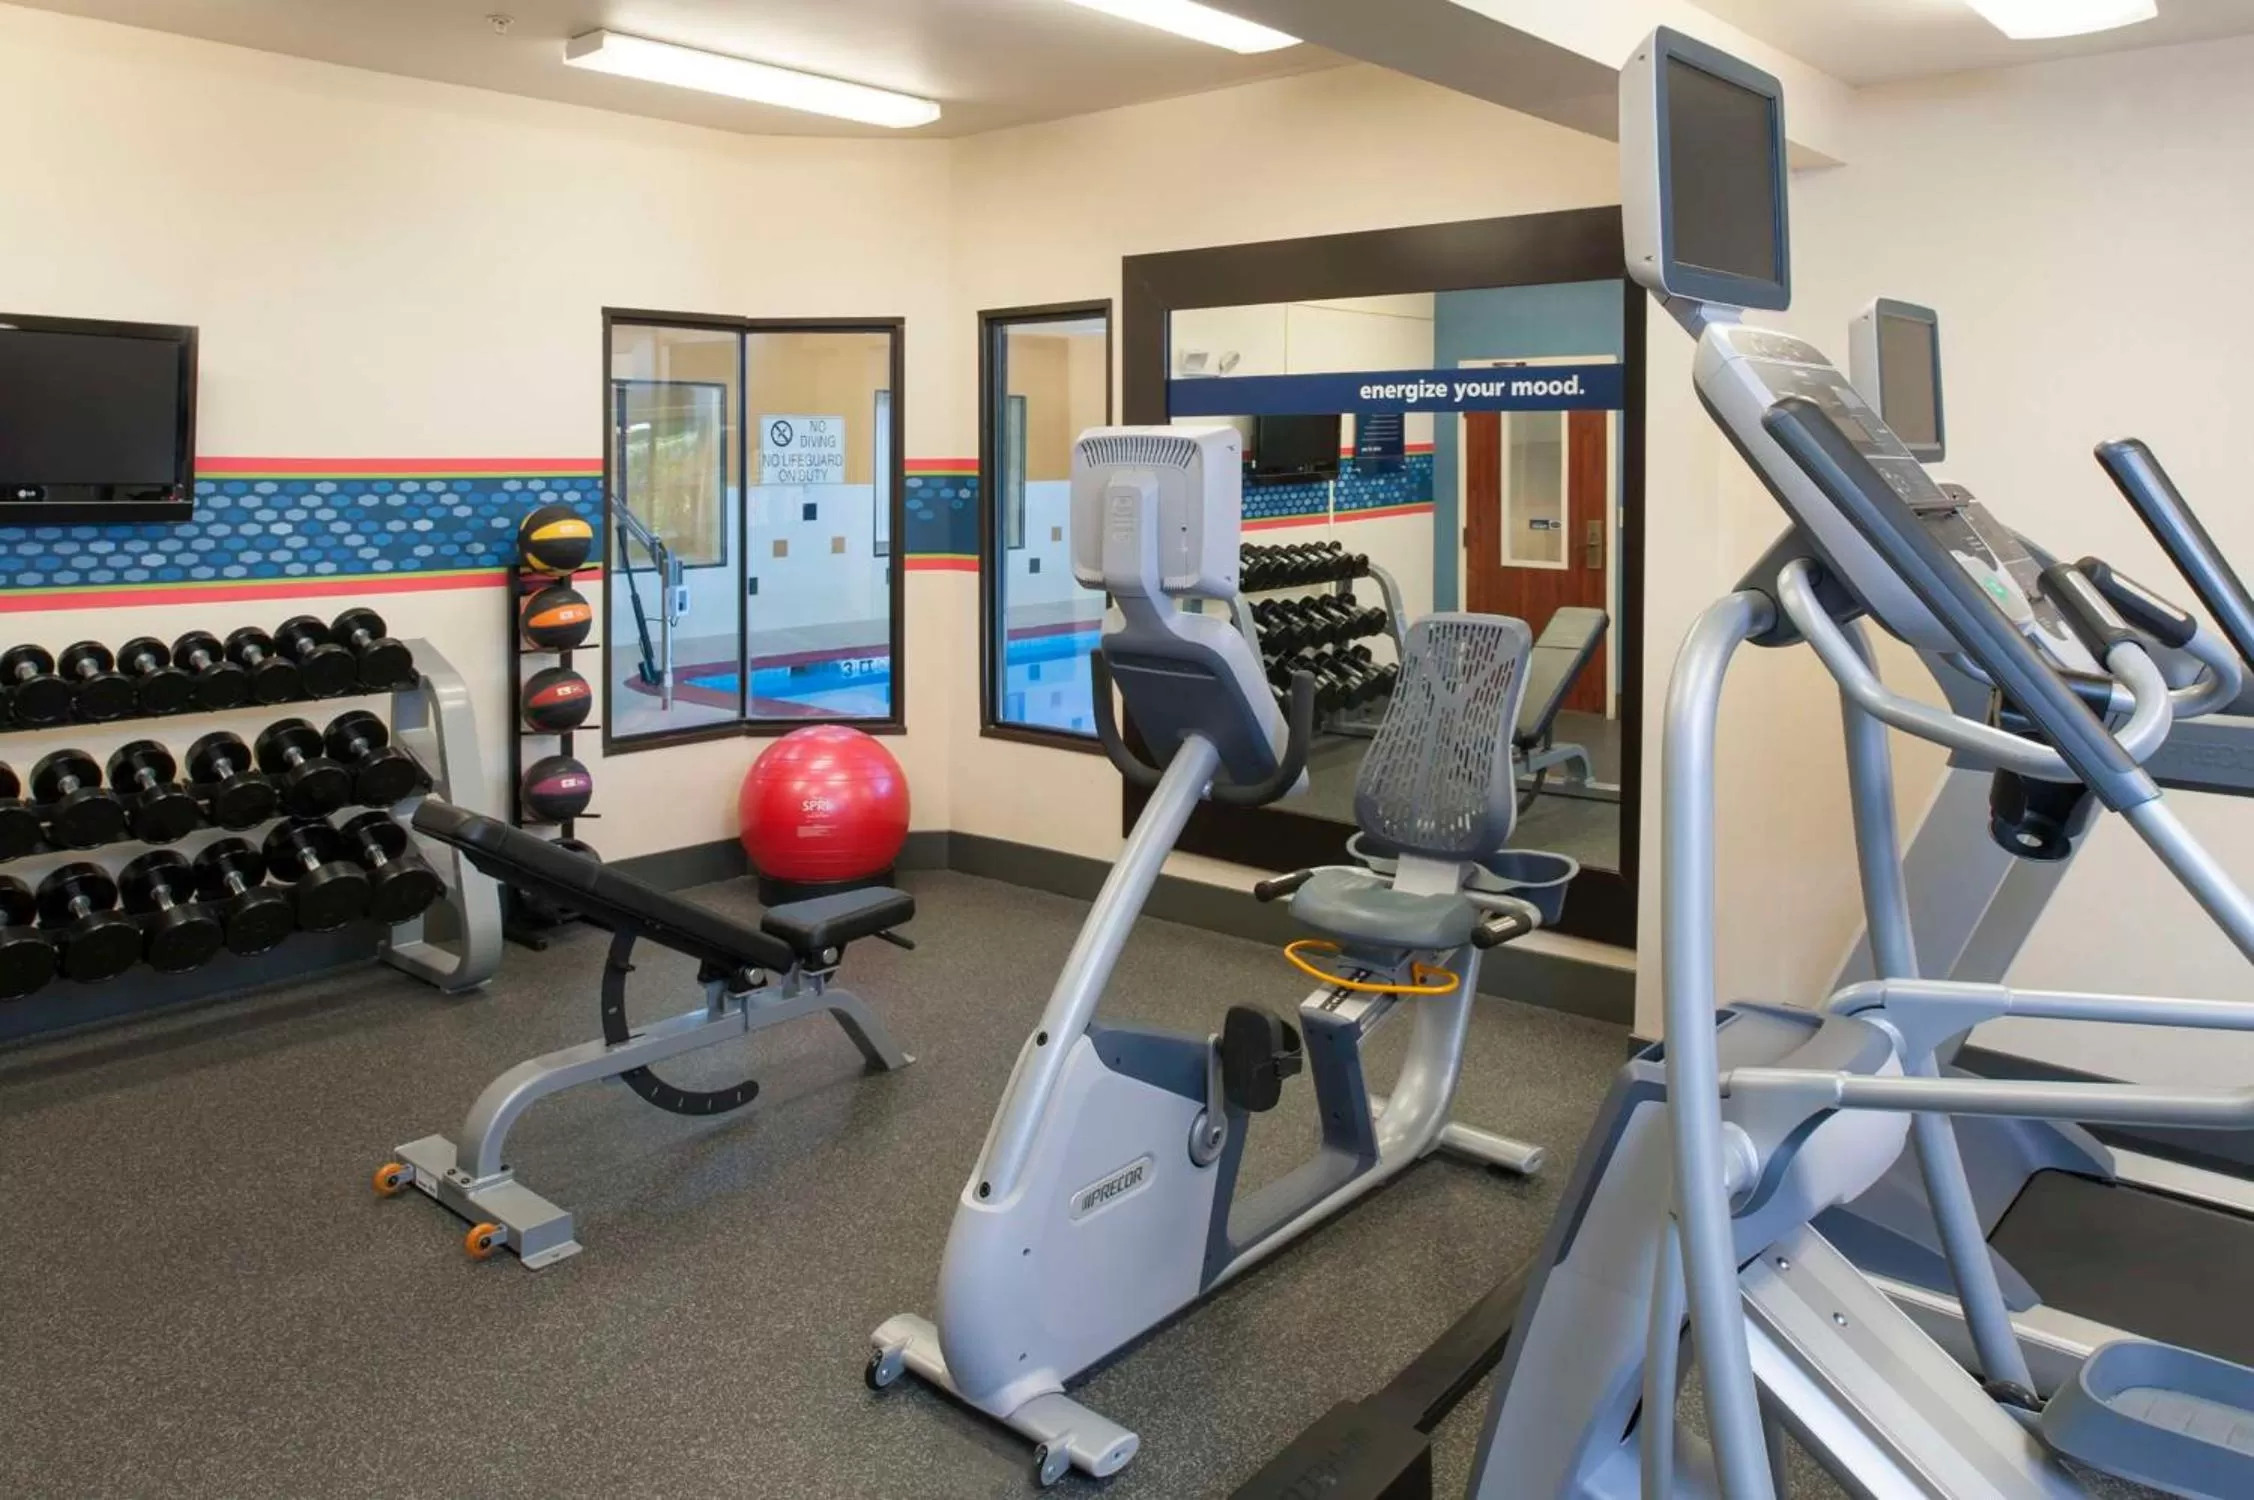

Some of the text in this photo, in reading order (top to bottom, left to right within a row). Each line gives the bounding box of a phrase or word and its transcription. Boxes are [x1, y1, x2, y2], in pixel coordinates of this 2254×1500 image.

[1359, 374, 1585, 403] energize your mood.
[809, 419, 827, 433] NO
[800, 434, 836, 448] DIVING
[762, 453, 843, 467] NO LIFEGUARD
[779, 468, 828, 482] ON DUTY
[1090, 1166, 1143, 1208] PRECOR
